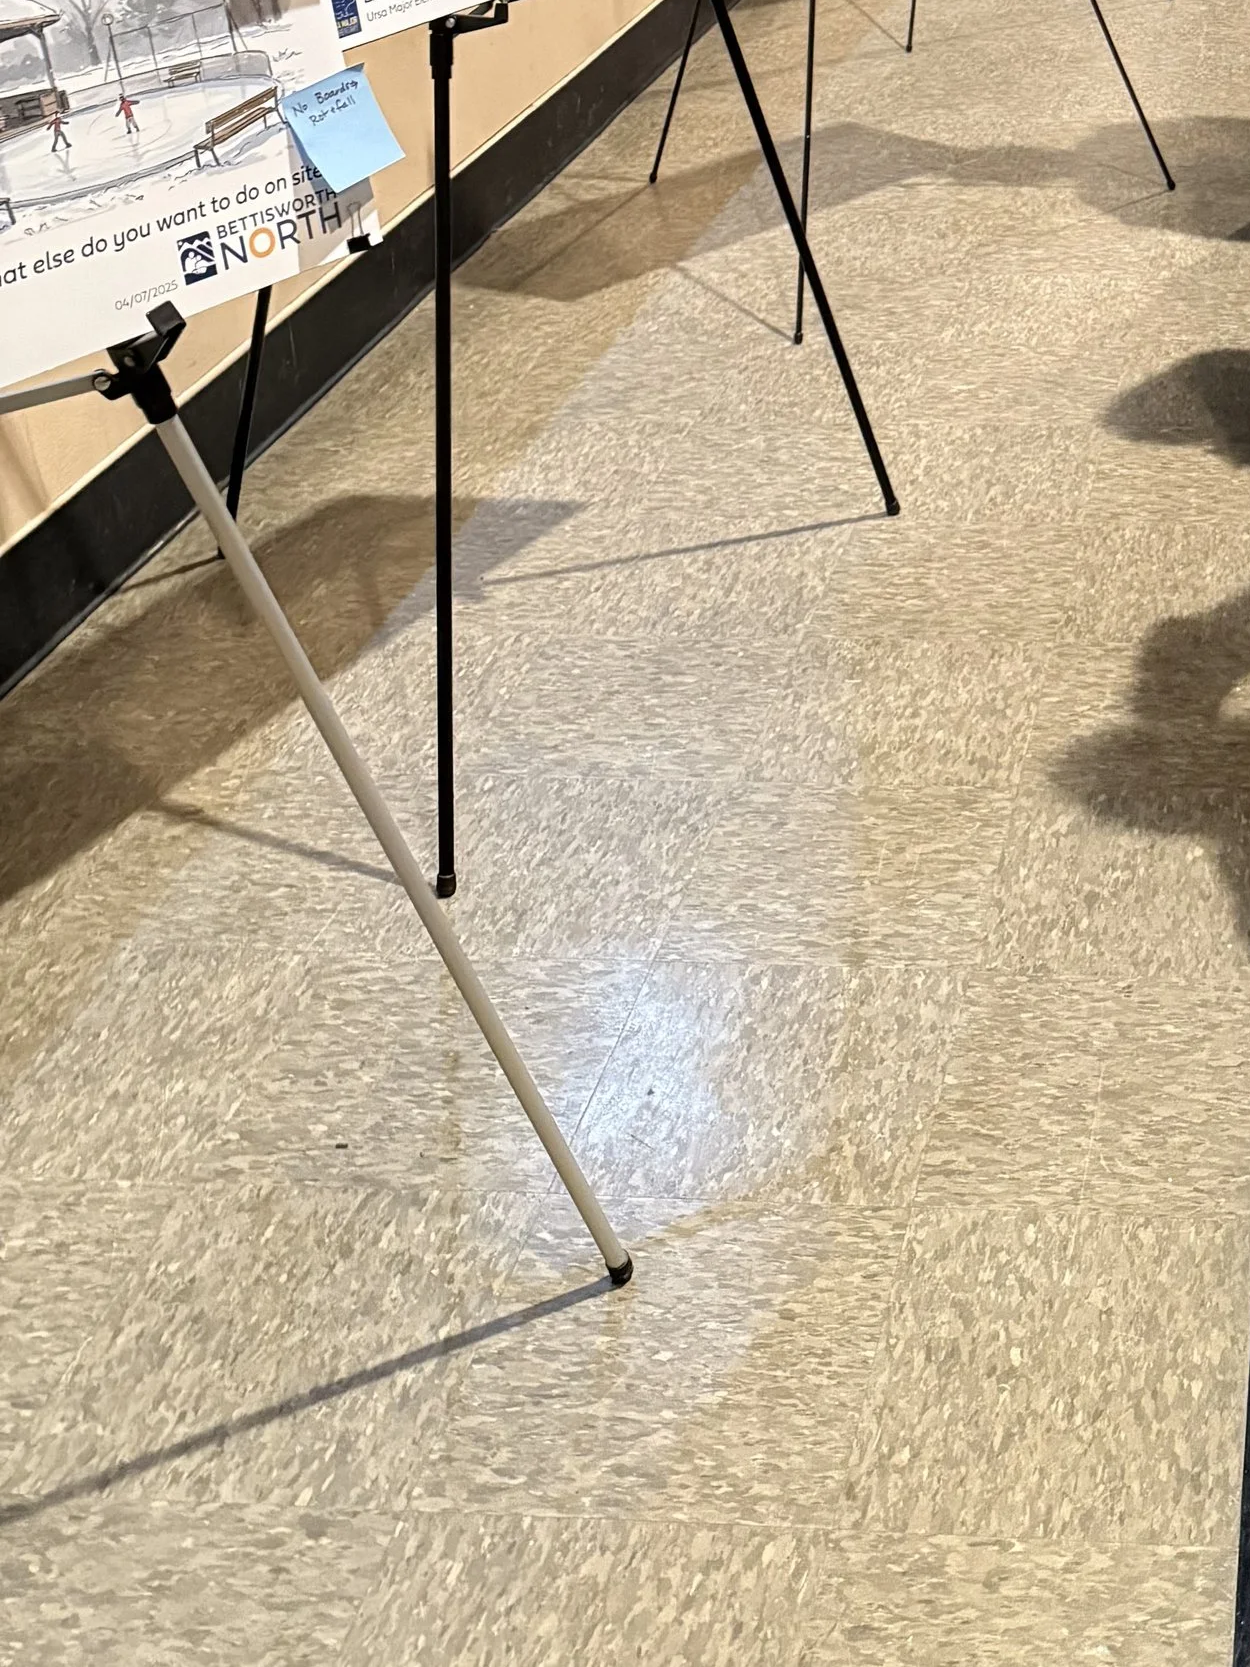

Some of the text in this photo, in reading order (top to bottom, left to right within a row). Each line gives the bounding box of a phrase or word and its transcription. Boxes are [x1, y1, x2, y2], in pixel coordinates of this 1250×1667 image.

[366, 10, 388, 22] Ursa
[389, 0, 413, 17] Major
[0, 261, 28, 287] at
[33, 249, 75, 274] else
[81, 236, 108, 257] do
[113, 226, 151, 252] you
[157, 205, 207, 232] want
[211, 195, 231, 214] to
[236, 185, 260, 206] do
[265, 177, 287, 194] on
[216, 188, 337, 240] BETTISWORTH
[220, 201, 342, 271] NORTH
[115, 279, 179, 312] 04/07/2025
